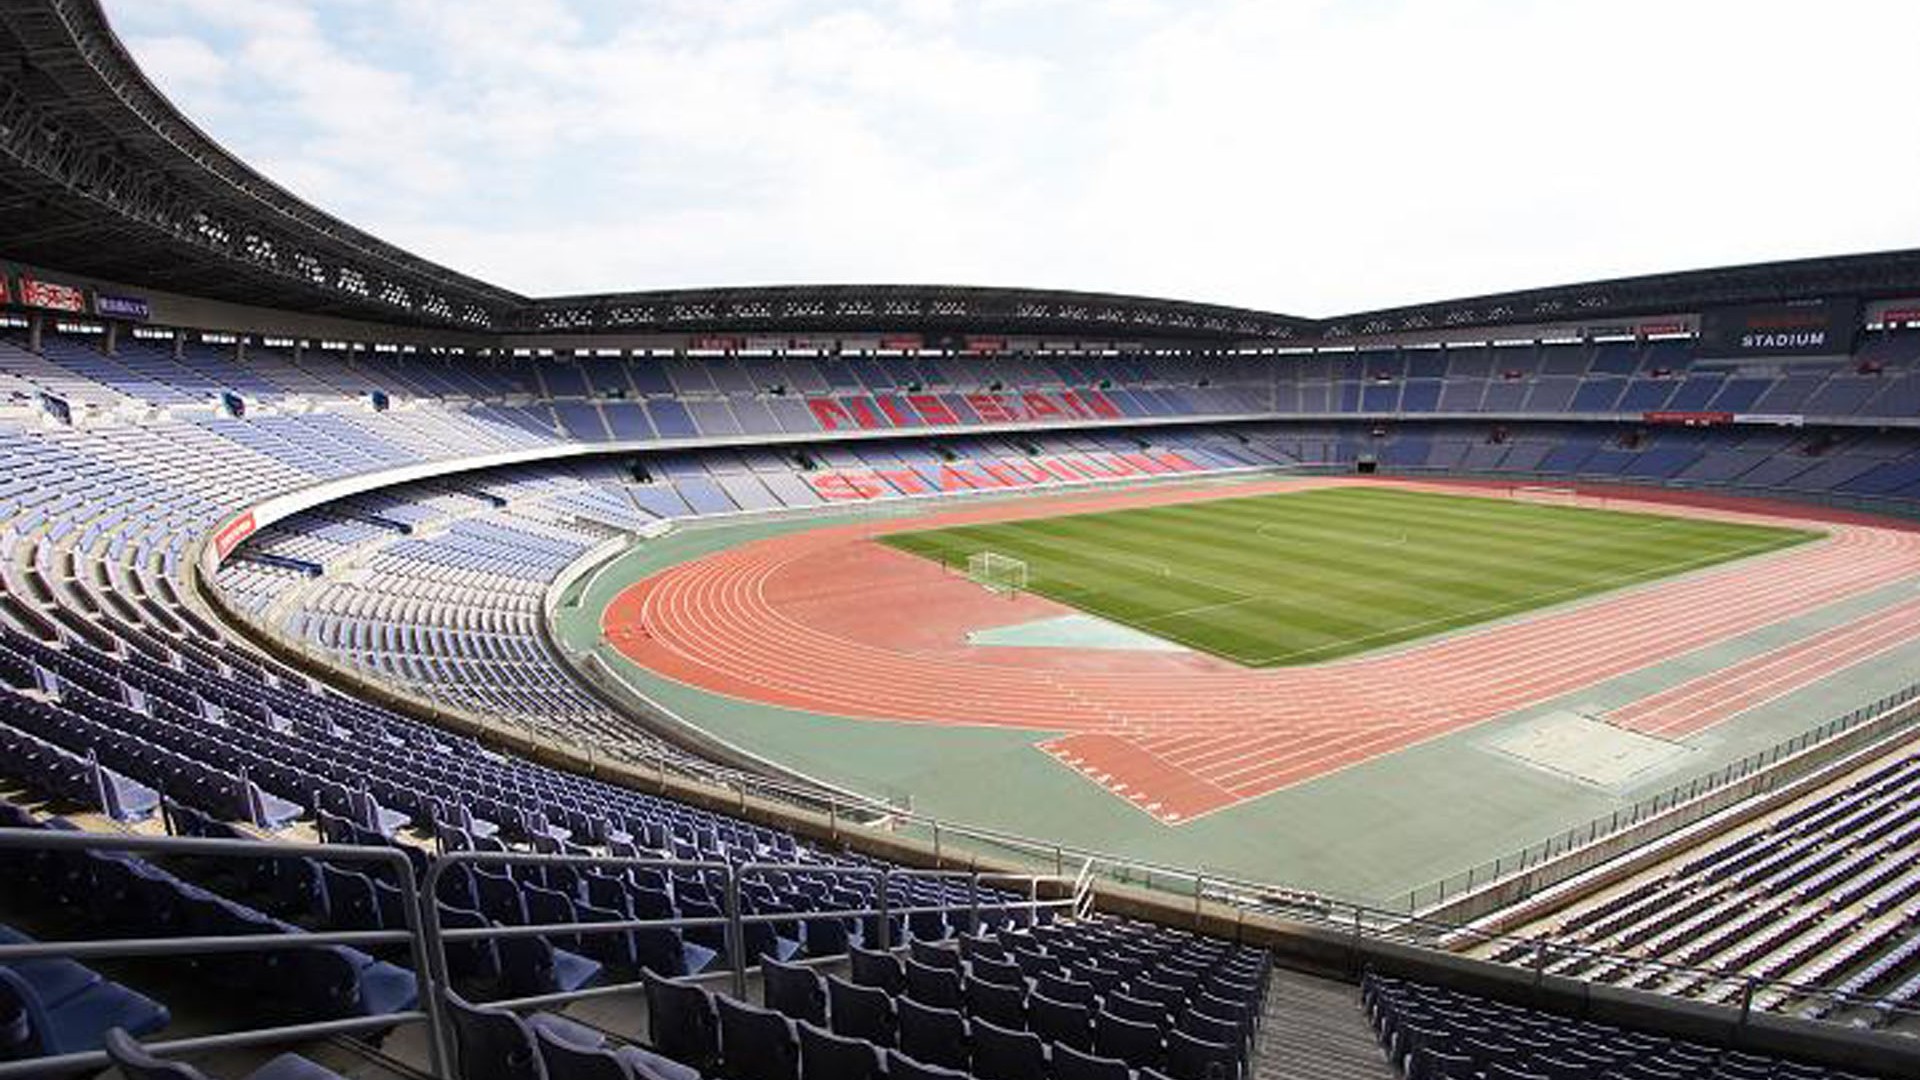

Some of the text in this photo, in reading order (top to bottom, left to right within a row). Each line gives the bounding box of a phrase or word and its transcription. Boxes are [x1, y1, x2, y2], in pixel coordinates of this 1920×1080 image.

[1741, 331, 1825, 348] STADIUM
[808, 392, 1119, 433] NISSAN
[811, 453, 1208, 499] STADIUM
